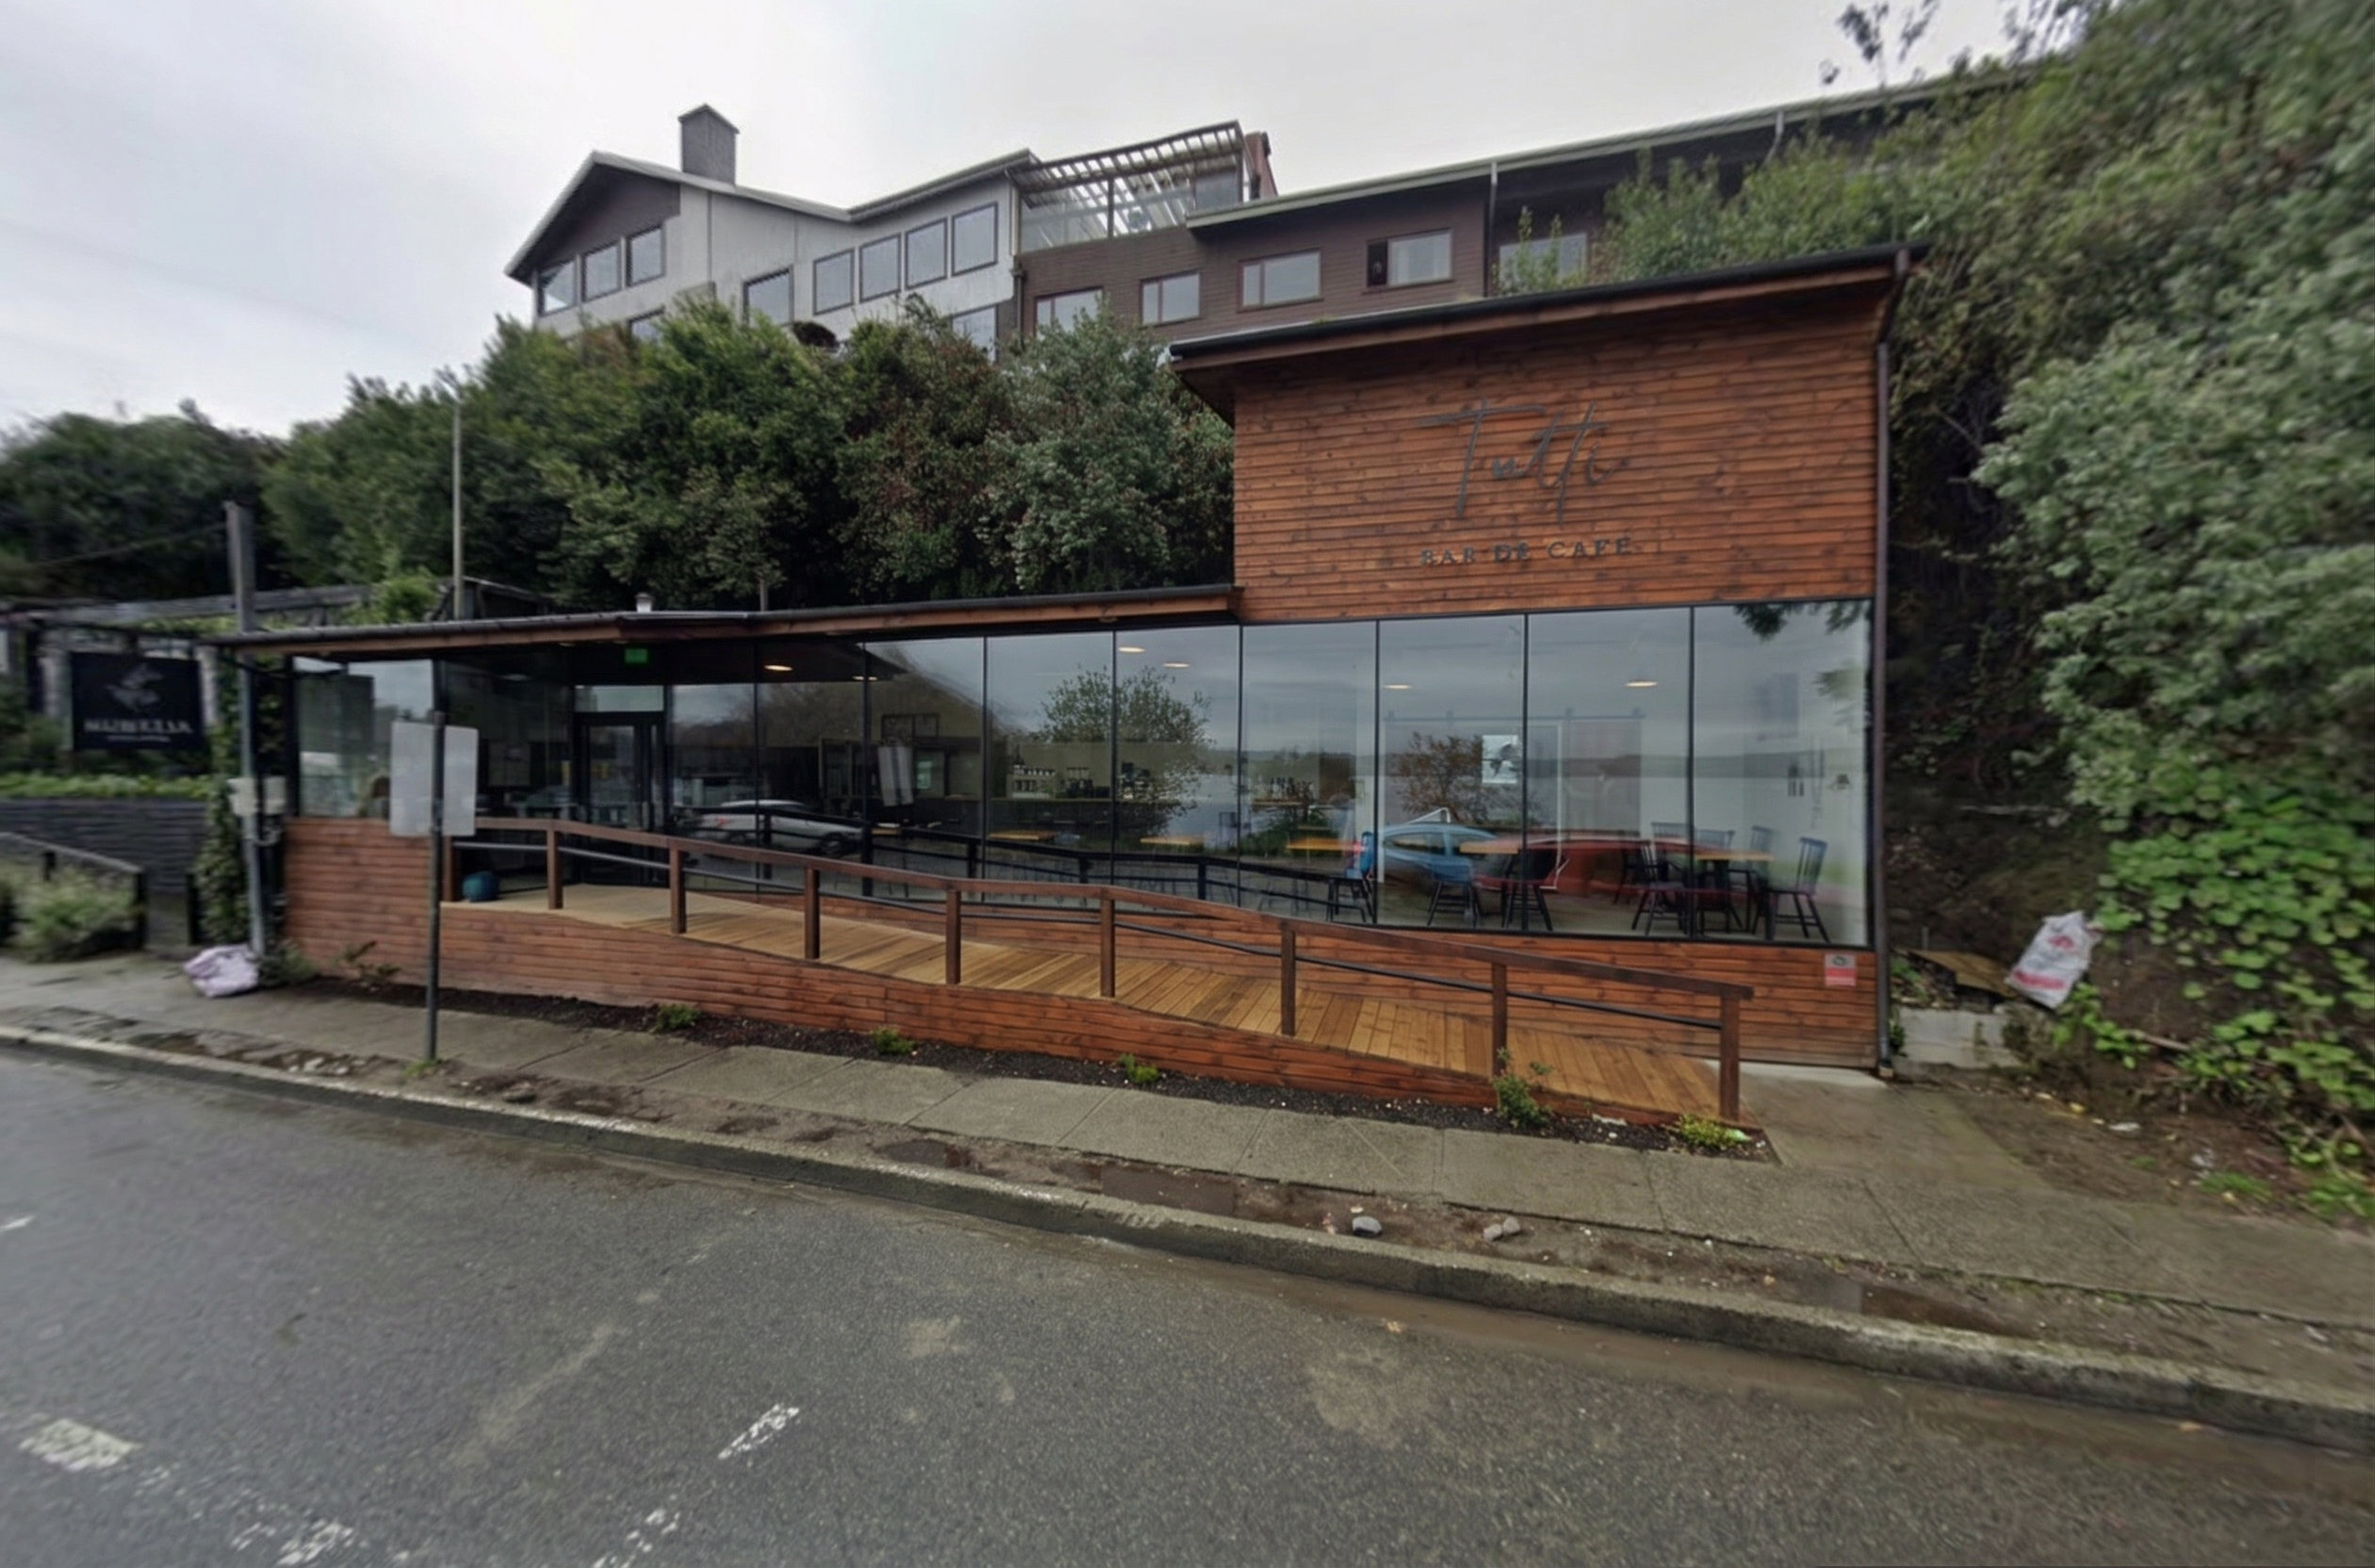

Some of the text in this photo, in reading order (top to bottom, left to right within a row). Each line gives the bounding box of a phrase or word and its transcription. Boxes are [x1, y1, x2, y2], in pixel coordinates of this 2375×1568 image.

[1413, 397, 1630, 529] Tutti
[1420, 547, 1476, 565] BAR
[1493, 542, 1531, 564] DE
